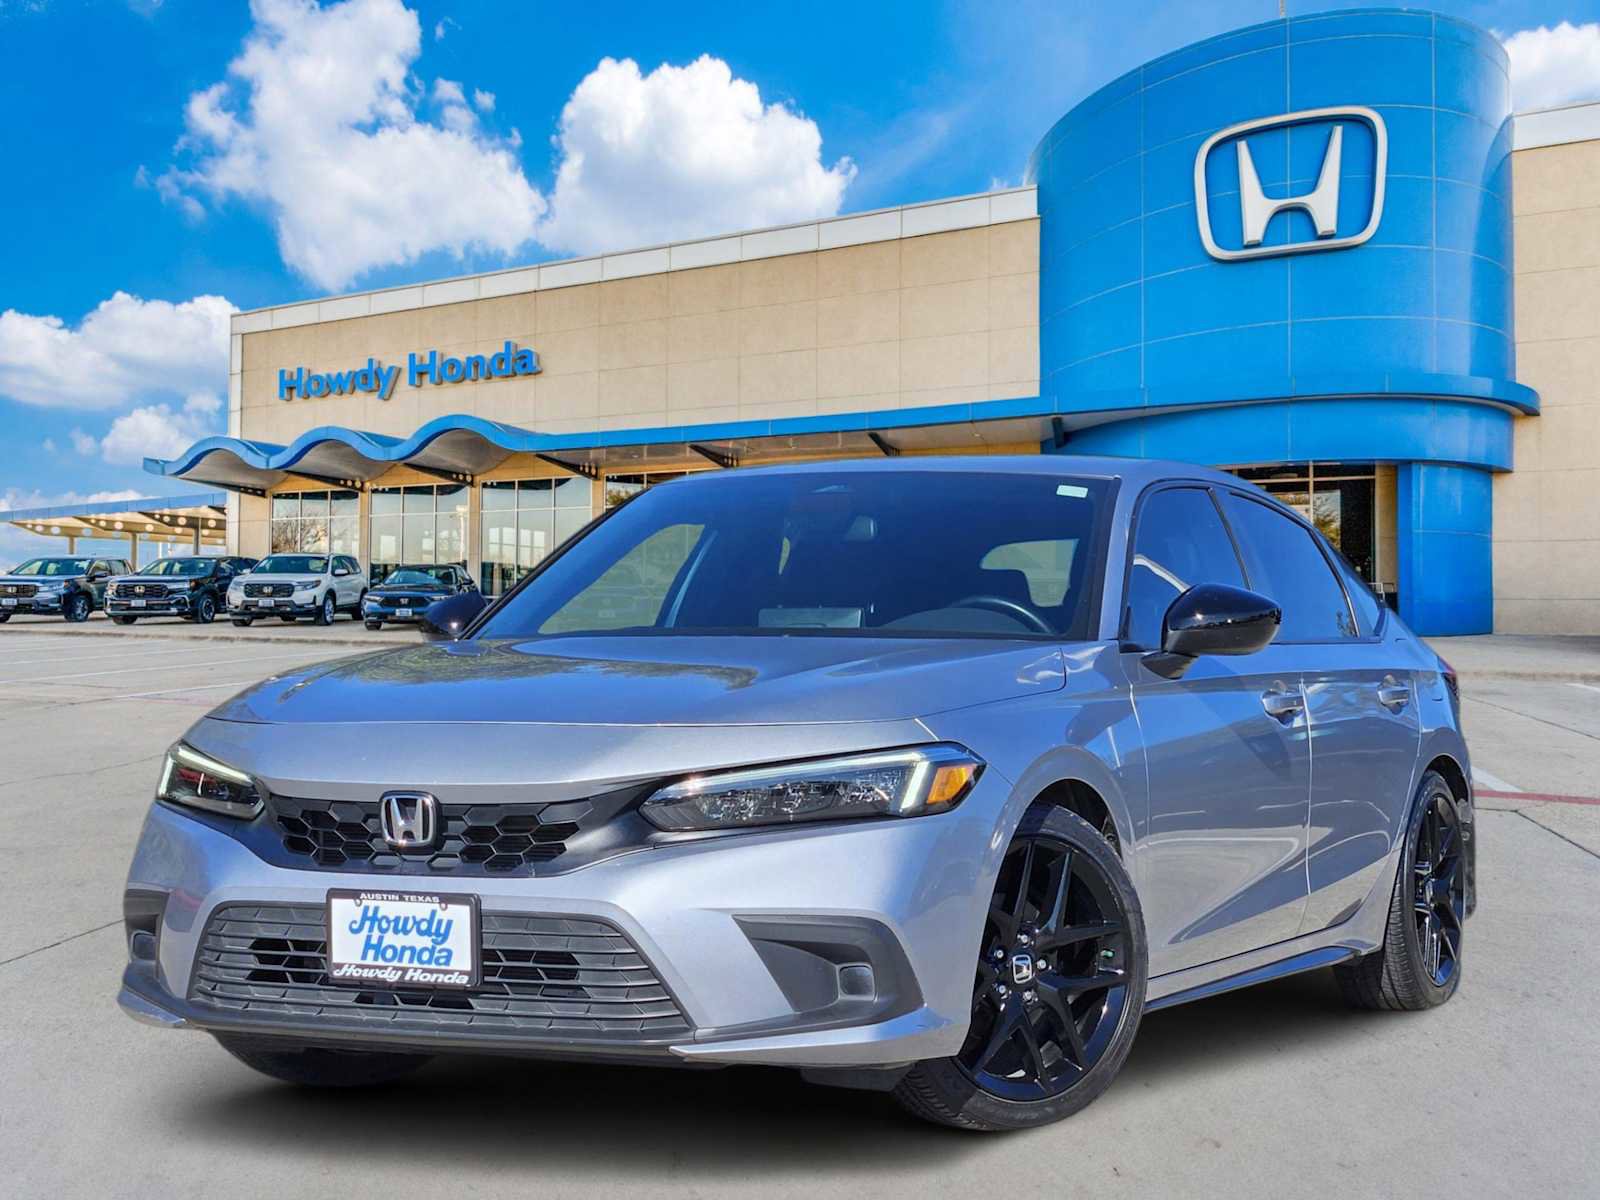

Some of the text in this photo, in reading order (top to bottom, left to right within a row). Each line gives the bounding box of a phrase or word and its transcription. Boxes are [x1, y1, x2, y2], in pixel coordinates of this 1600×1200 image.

[279, 341, 541, 400] Howdy Honda
[360, 892, 440, 903] AUSTIN TEXAS
[349, 905, 453, 945] Howdy
[361, 935, 453, 967] Honda
[334, 965, 469, 984] Howdy Honda
